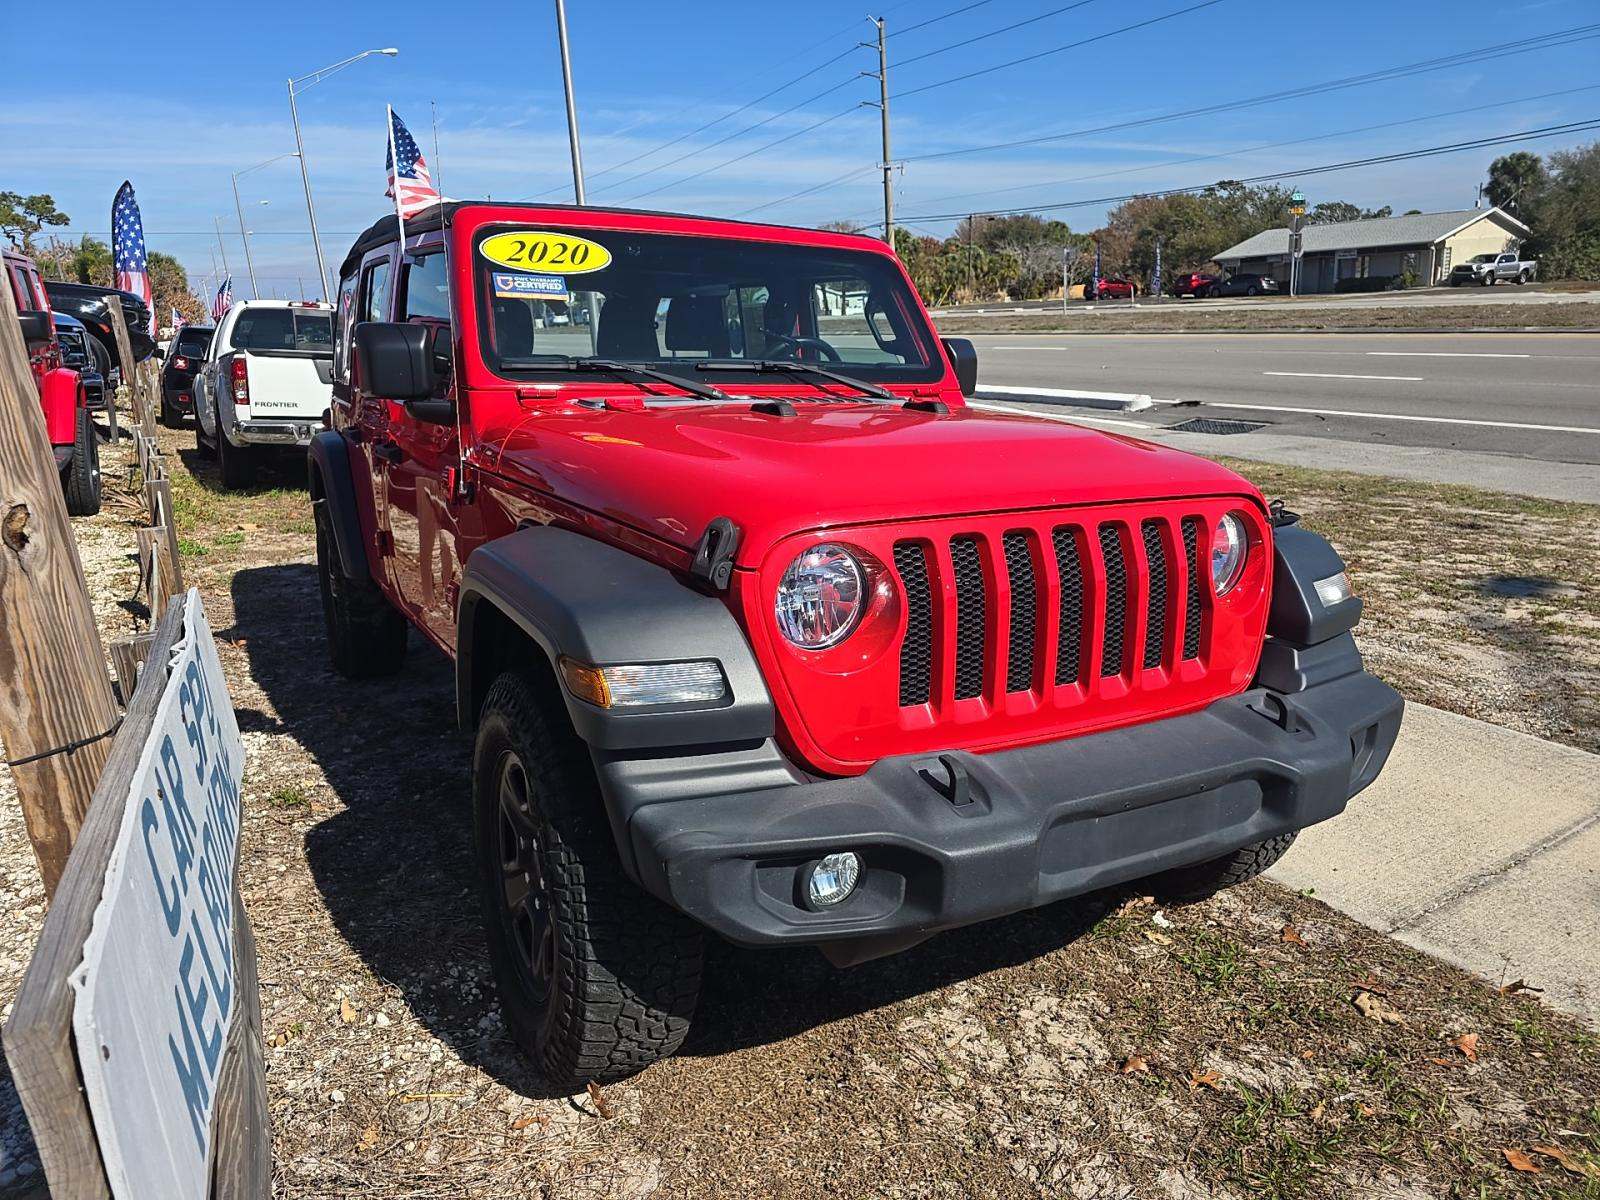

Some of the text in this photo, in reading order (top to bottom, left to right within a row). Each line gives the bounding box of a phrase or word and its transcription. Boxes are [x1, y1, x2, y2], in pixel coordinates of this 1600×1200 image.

[505, 240, 589, 265] 2020
[514, 281, 563, 290] CERTIFIED
[142, 734, 197, 937] CAR
[169, 717, 238, 1161] MELBOURNE
